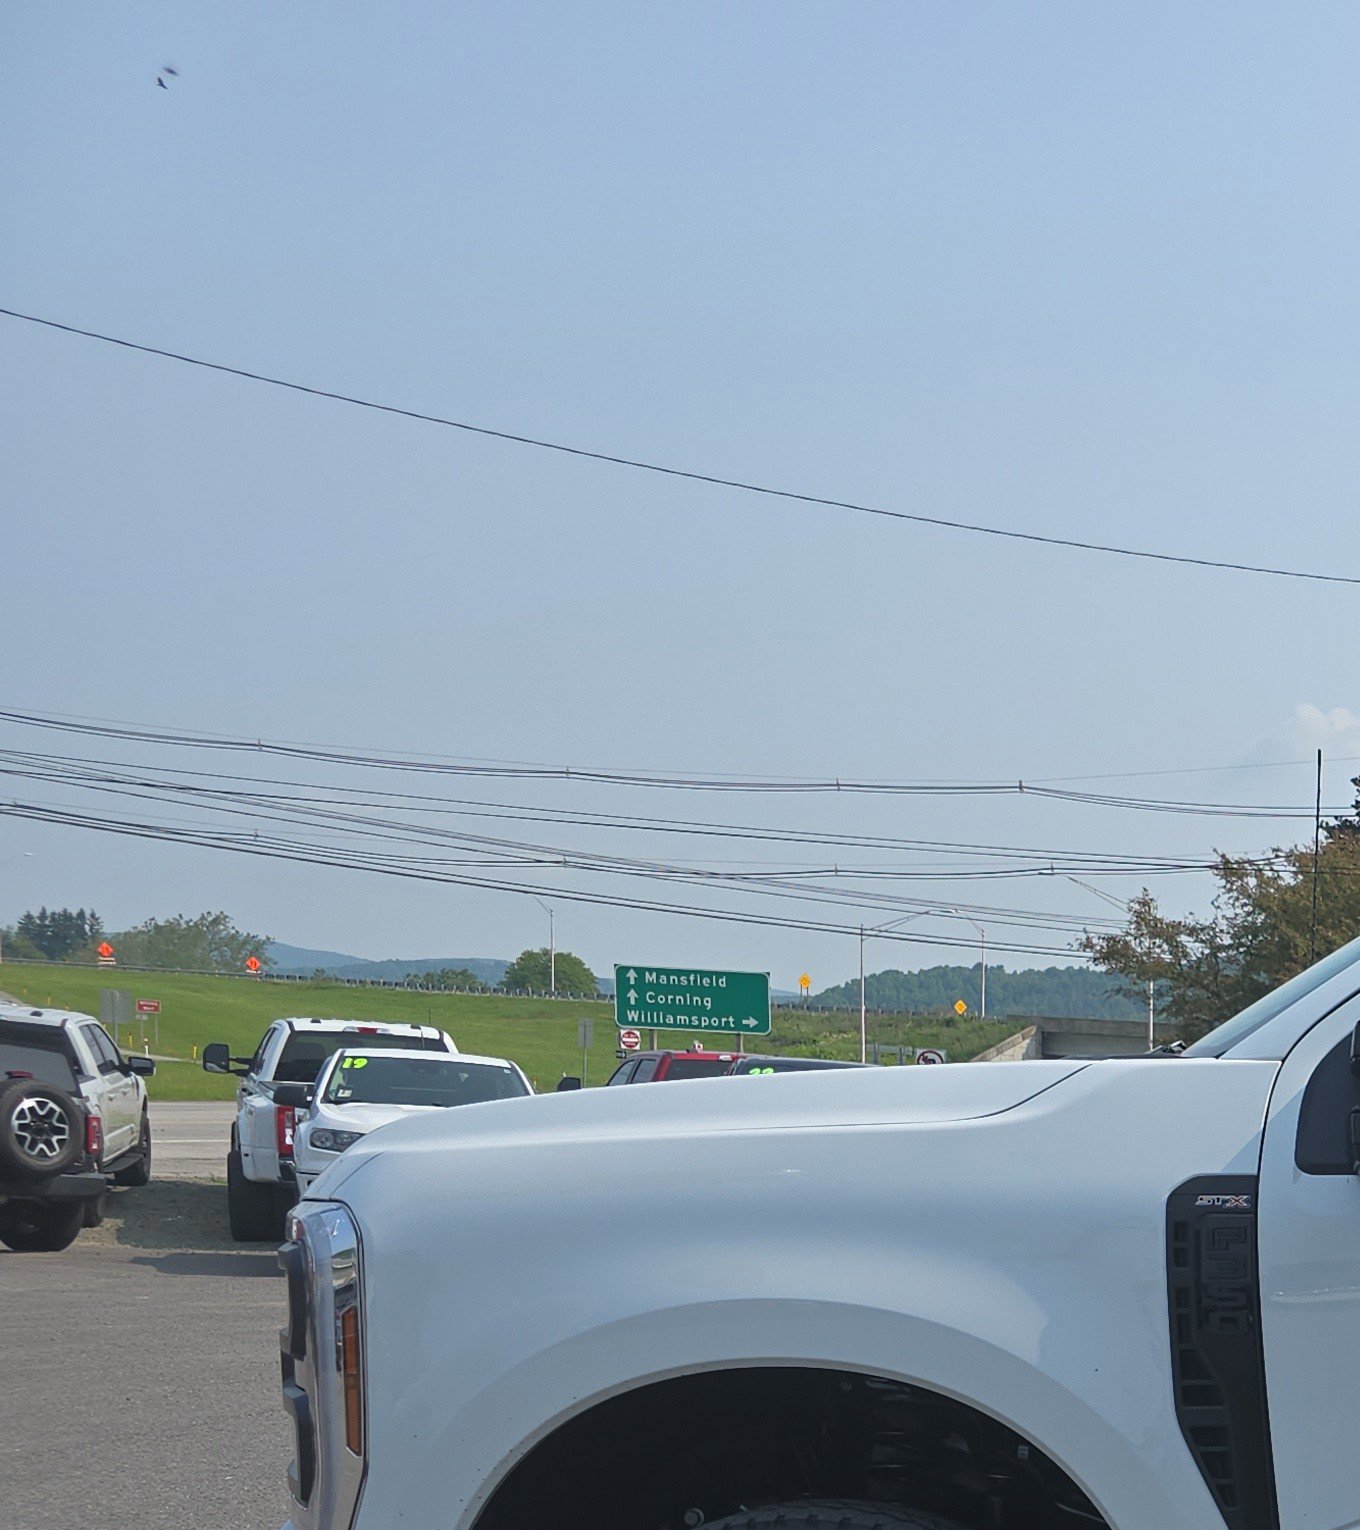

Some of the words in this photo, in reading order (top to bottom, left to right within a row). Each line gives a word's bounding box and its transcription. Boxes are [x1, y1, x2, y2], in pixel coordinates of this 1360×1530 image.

[645, 971, 727, 988] Mansfield
[646, 991, 712, 1010] Corning
[626, 1010, 735, 1028] Williamsport
[342, 1057, 368, 1069] 19
[1195, 1195, 1251, 1208] STX
